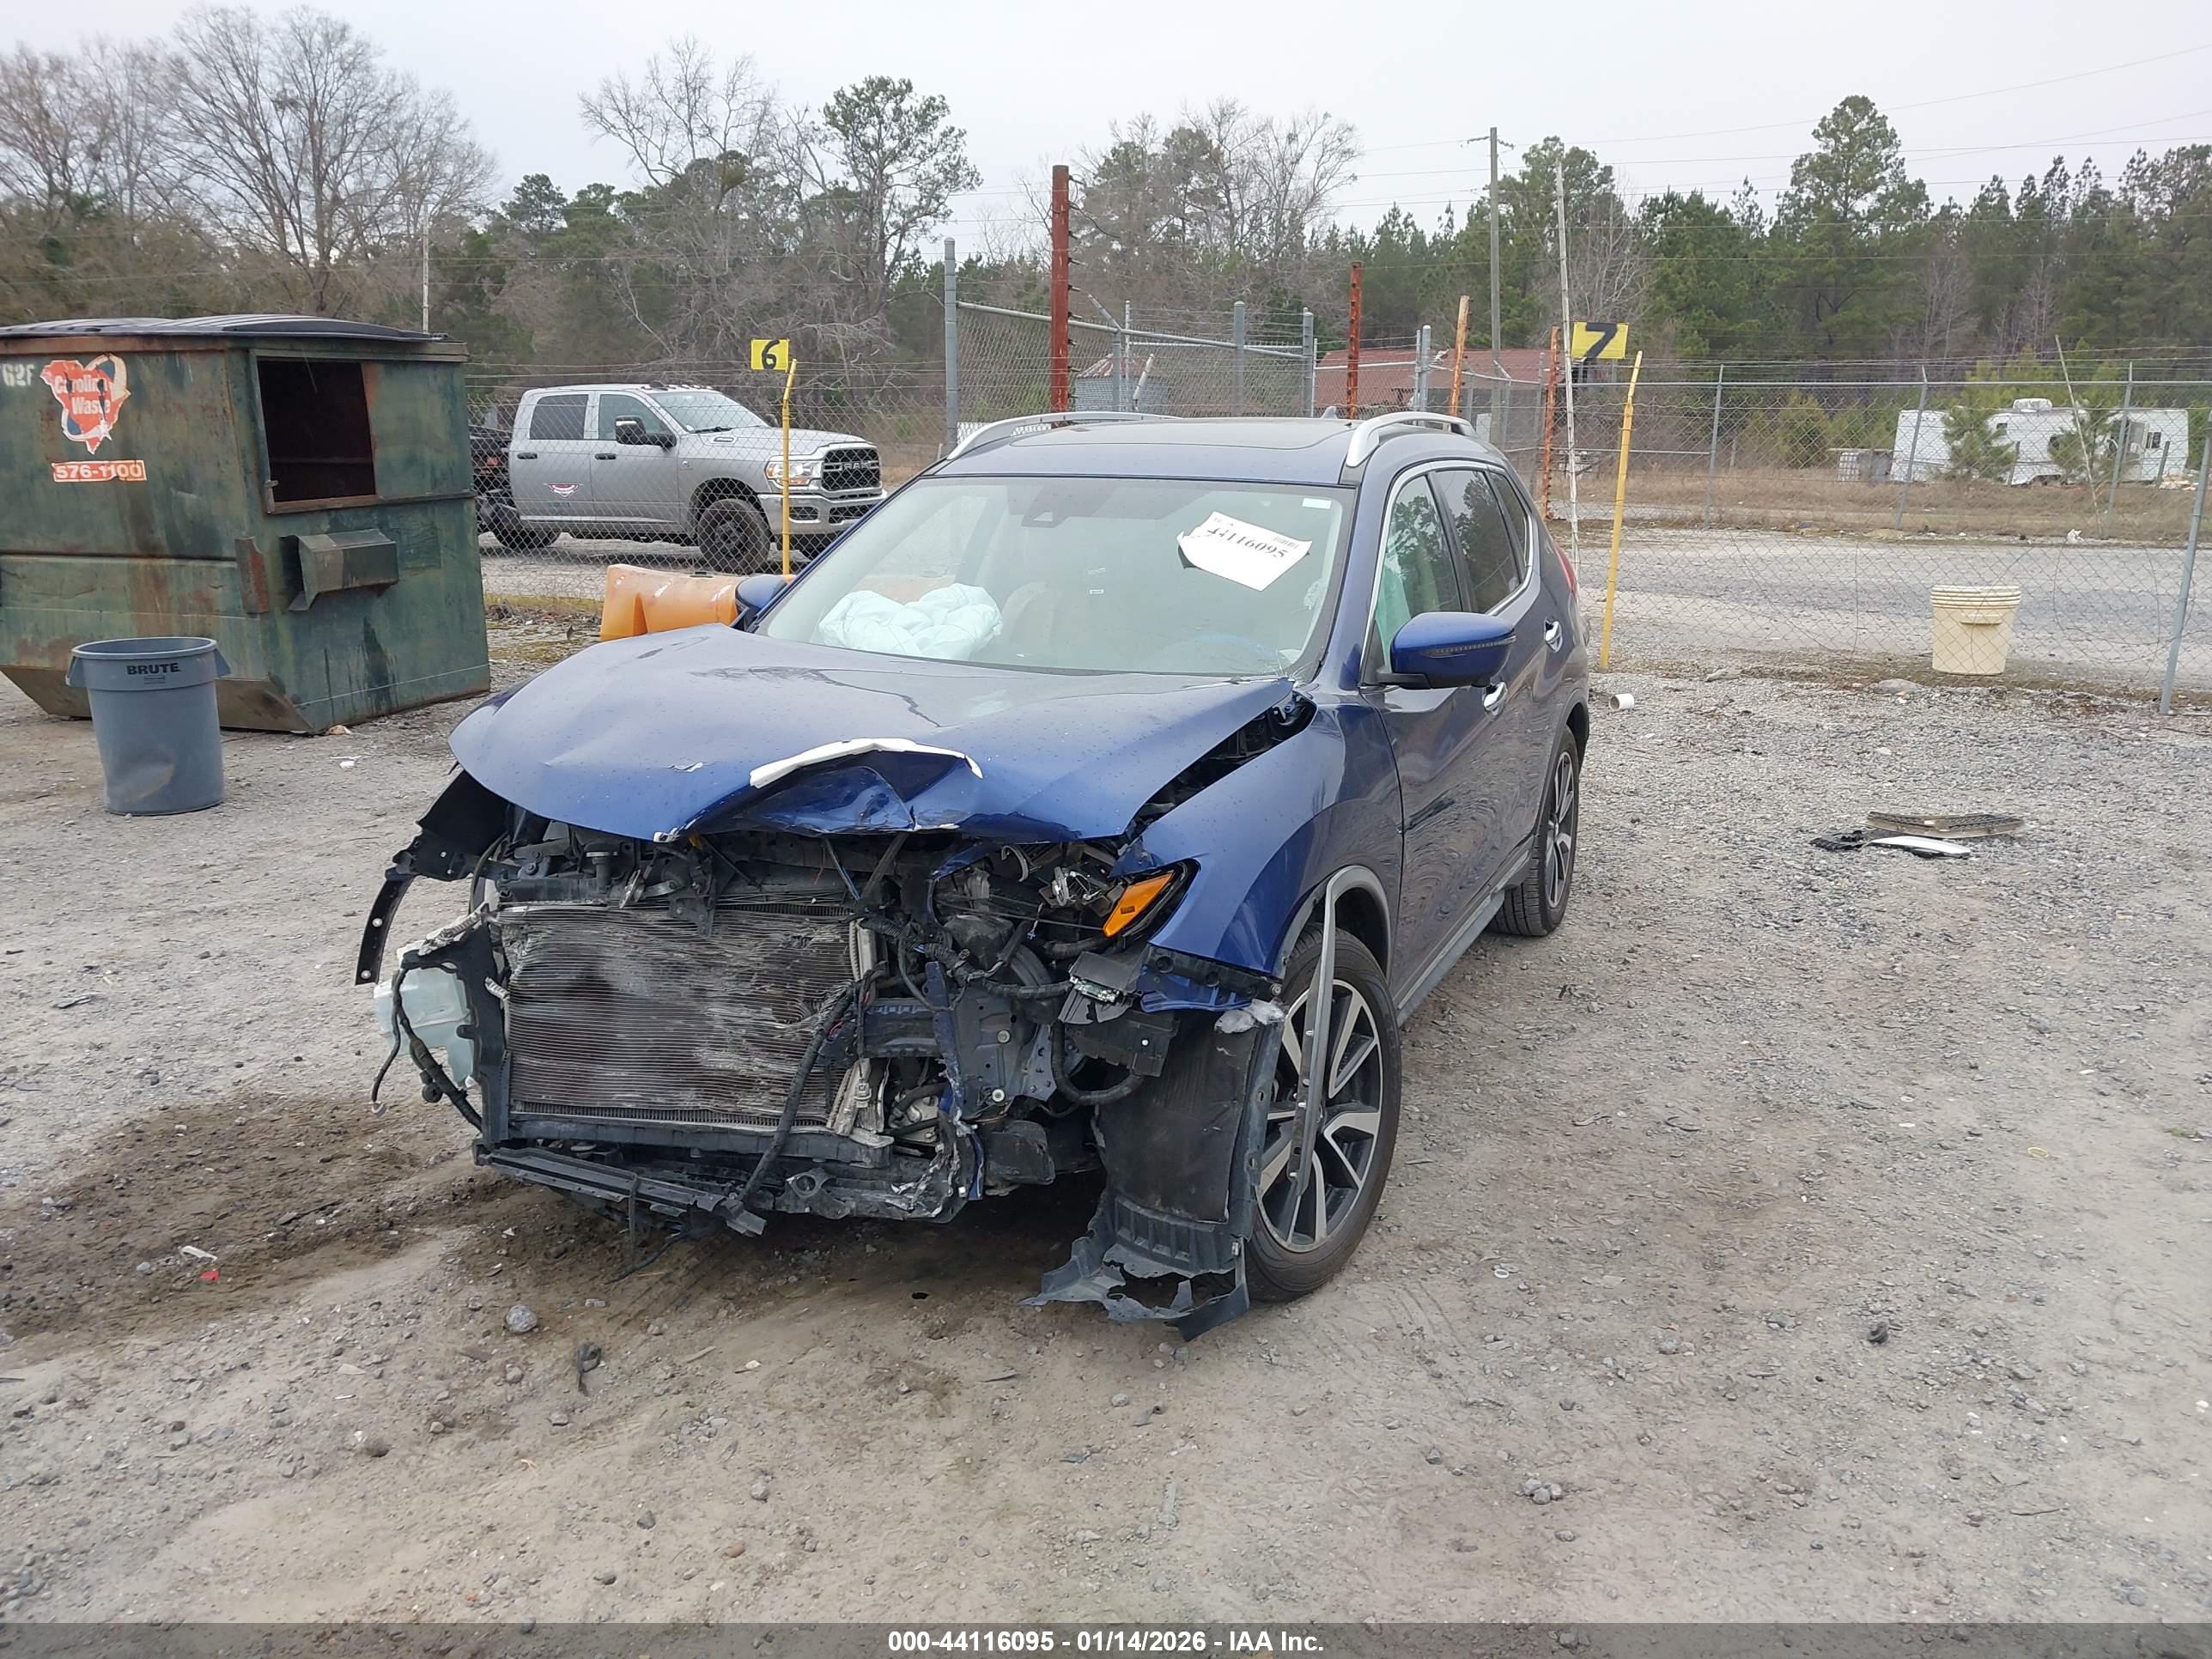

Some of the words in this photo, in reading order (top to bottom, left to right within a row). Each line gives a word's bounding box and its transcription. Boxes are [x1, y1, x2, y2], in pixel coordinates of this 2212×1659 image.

[762, 339, 780, 370] 6
[1583, 322, 1618, 361] 7
[0, 363, 34, 386] 62F
[55, 464, 142, 479] 576-1100
[1206, 527, 1289, 558] 44116095
[126, 663, 180, 675] BRUTE
